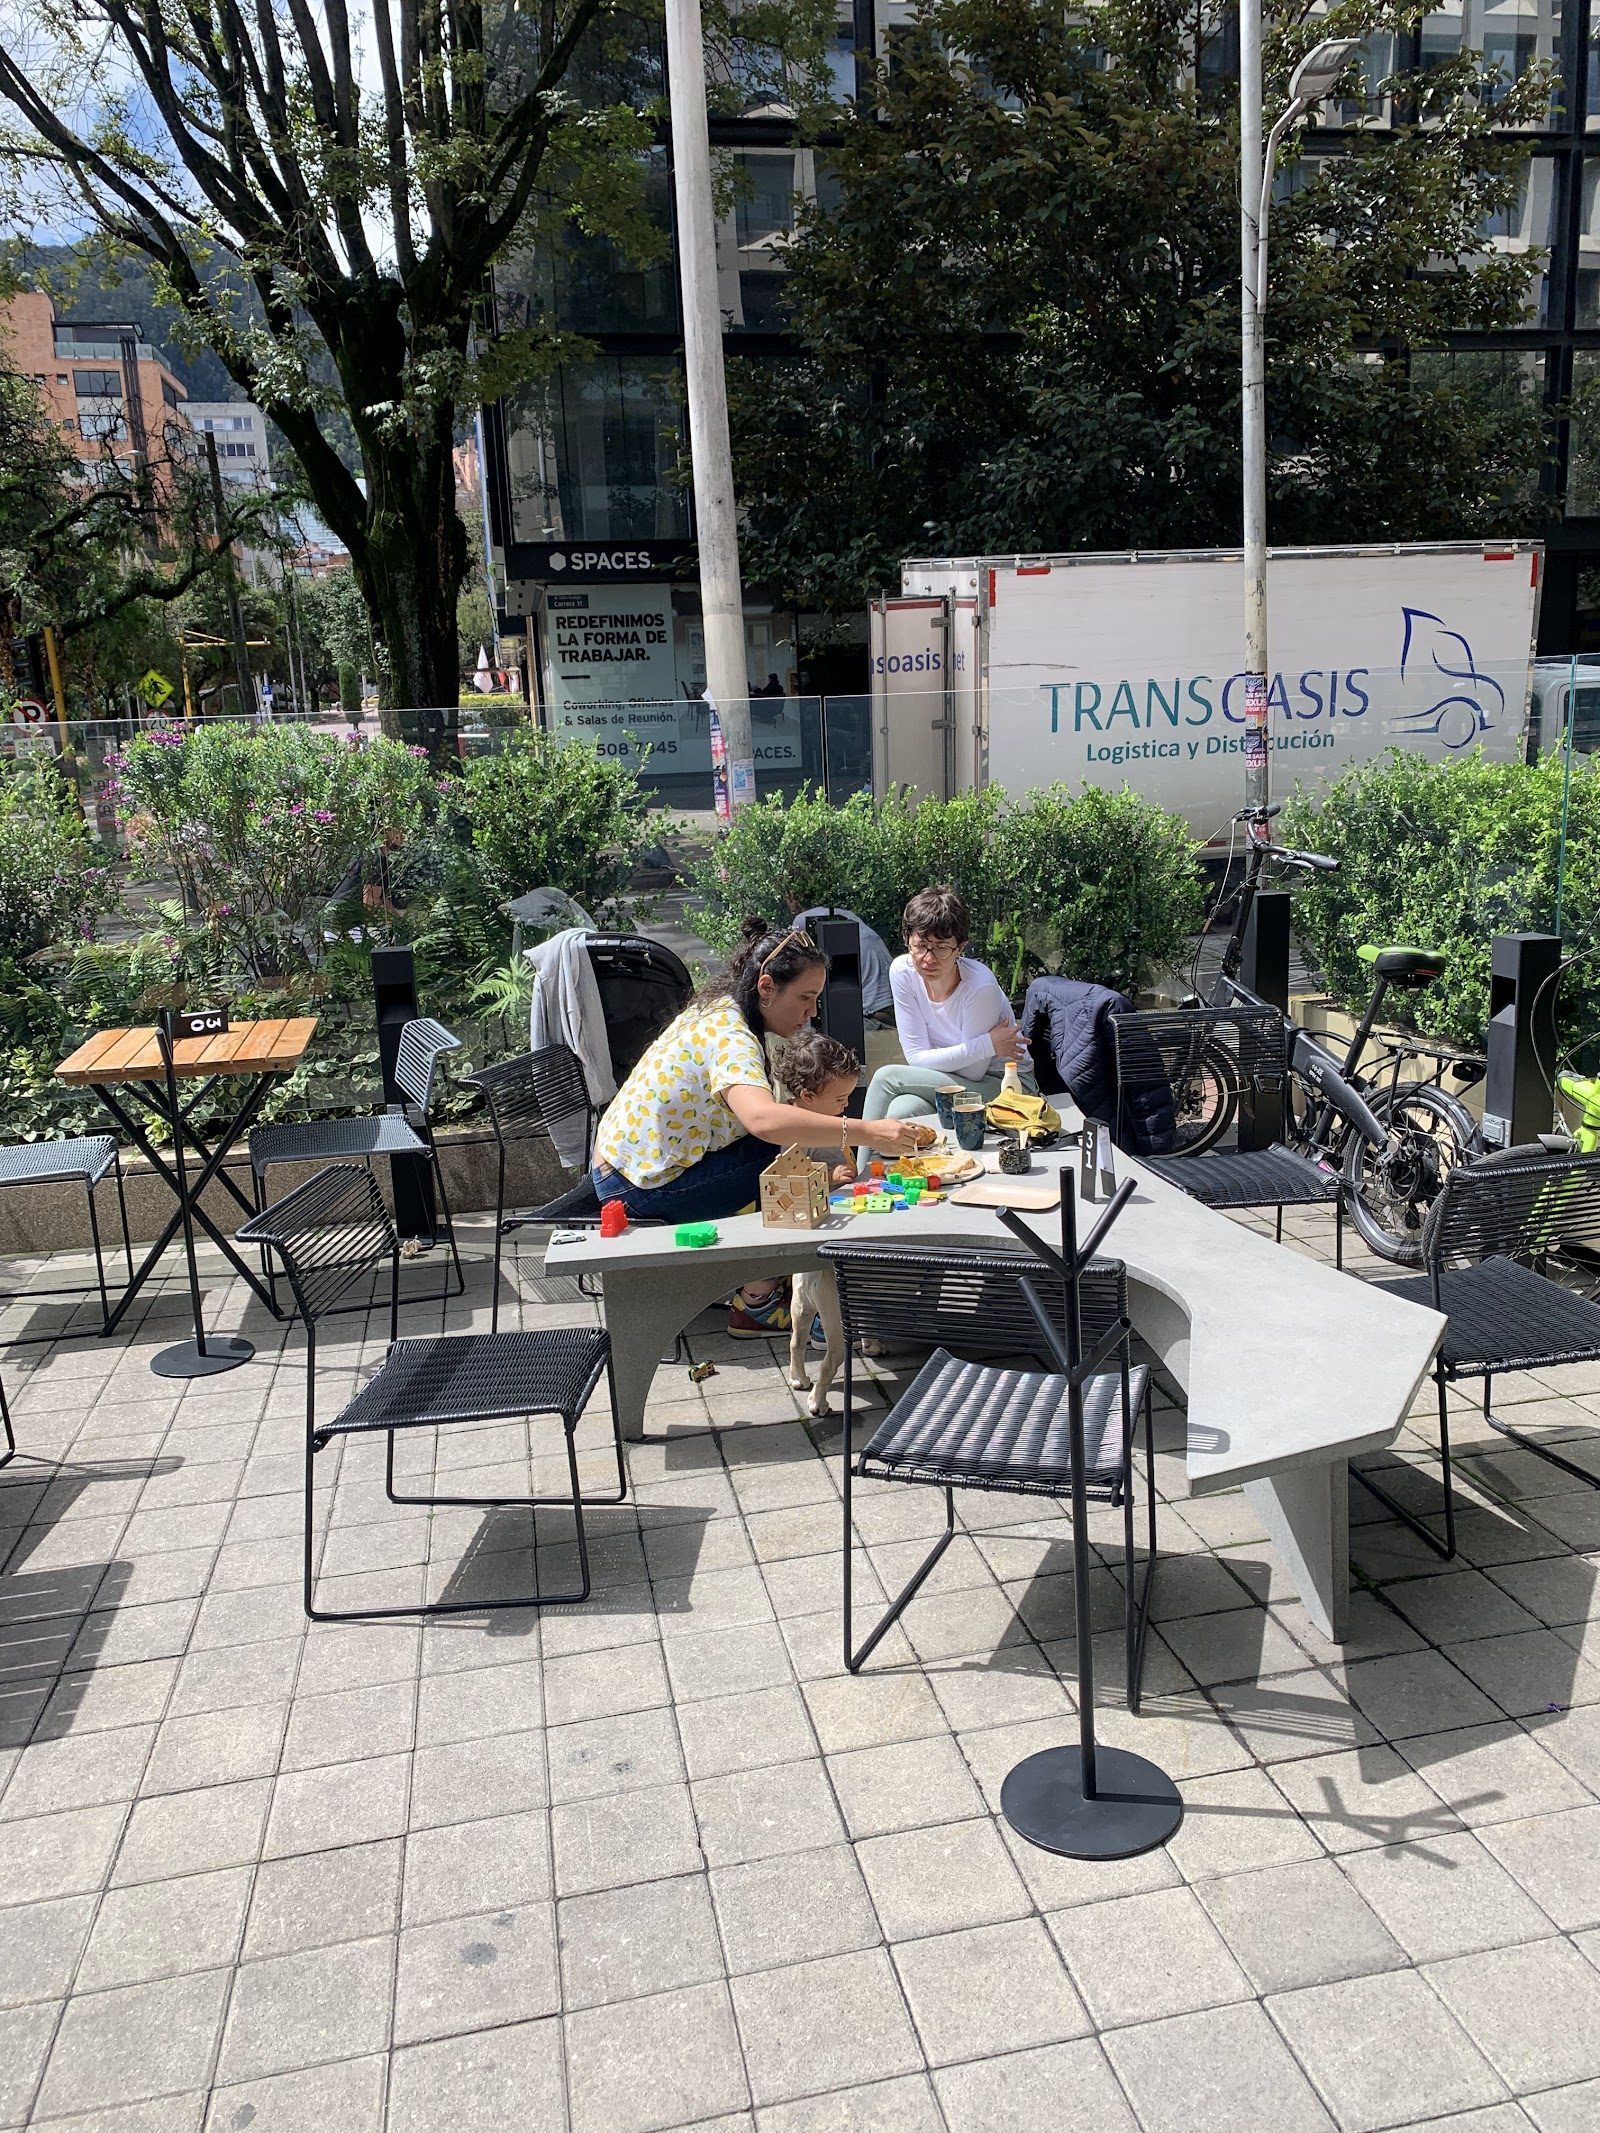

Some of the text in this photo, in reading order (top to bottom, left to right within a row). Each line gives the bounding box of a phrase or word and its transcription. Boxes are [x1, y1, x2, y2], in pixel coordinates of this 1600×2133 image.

[555, 613, 665, 629] REDEFINIMOS
[557, 630, 667, 646] LA FORMA DE
[558, 647, 651, 663] TRABAJAR.
[563, 697, 674, 711] Coworking, Oficinas
[564, 711, 677, 726] & Salas de Reunión.
[596, 742, 629, 756] 508
[1187, 741, 1200, 760] y
